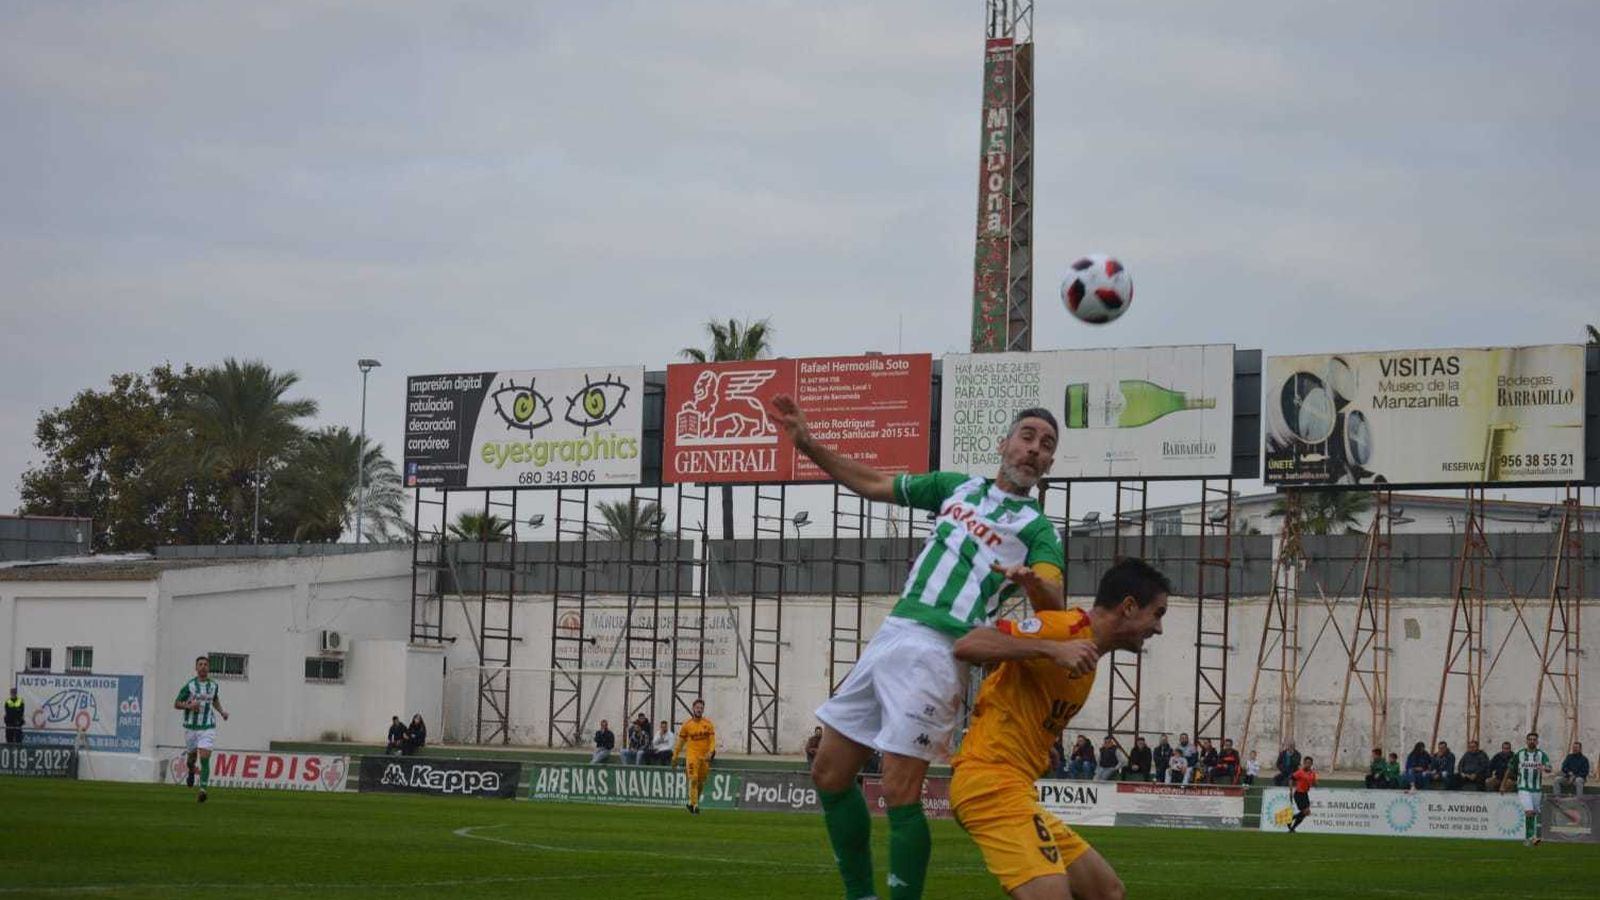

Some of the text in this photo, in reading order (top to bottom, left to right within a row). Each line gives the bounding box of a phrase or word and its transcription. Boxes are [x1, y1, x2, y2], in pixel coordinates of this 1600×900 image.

[801, 359, 909, 373] Rafael Hermosilla Soto
[1379, 356, 1460, 377] VISITAS
[411, 376, 482, 393] impresión digital
[955, 373, 1040, 385] VINOS BLANCOS
[1378, 377, 1459, 393] Museo de la
[1497, 376, 1553, 389] Bodegas
[955, 384, 1040, 399] PARA DISCUTIR
[1497, 388, 1574, 407] BARBADILLO
[410, 398, 453, 412] rotulación
[1372, 394, 1459, 409] Manzanilla
[954, 410, 984, 424] QUE
[989, 409, 1007, 424] LO
[409, 418, 456, 431] decoración
[806, 418, 875, 431] osario Rodríguez
[954, 425, 984, 436] HASTA
[842, 428, 879, 440] Sanlúcar
[881, 428, 903, 438] 2015
[904, 428, 920, 438] S.L.
[408, 436, 449, 452] corpóreos
[481, 431, 638, 470] eyesgraphics
[953, 437, 991, 452] PERO
[1162, 442, 1217, 455] BARBADILLO
[675, 447, 778, 474] GENERALI
[953, 454, 969, 464] UN
[1501, 454, 1574, 468] 956 38 55 21
[1442, 463, 1486, 472] RESERVAS
[519, 471, 542, 484] 680
[546, 471, 568, 483] 343
[571, 470, 596, 482] 806
[20, 678, 117, 690] AUTO-RECAMBIOS
[193, 752, 321, 782] MEDIS
[410, 765, 500, 793] Kappa
[536, 767, 608, 796] ARENAS
[712, 774, 733, 801] SL
[745, 783, 817, 808] ProLiga
[1036, 786, 1098, 805] PYSAN
[1327, 800, 1376, 810] SANLÚCAR
[1428, 804, 1488, 813] E.S. AVENIDA
[1033, 814, 1051, 842] 6
